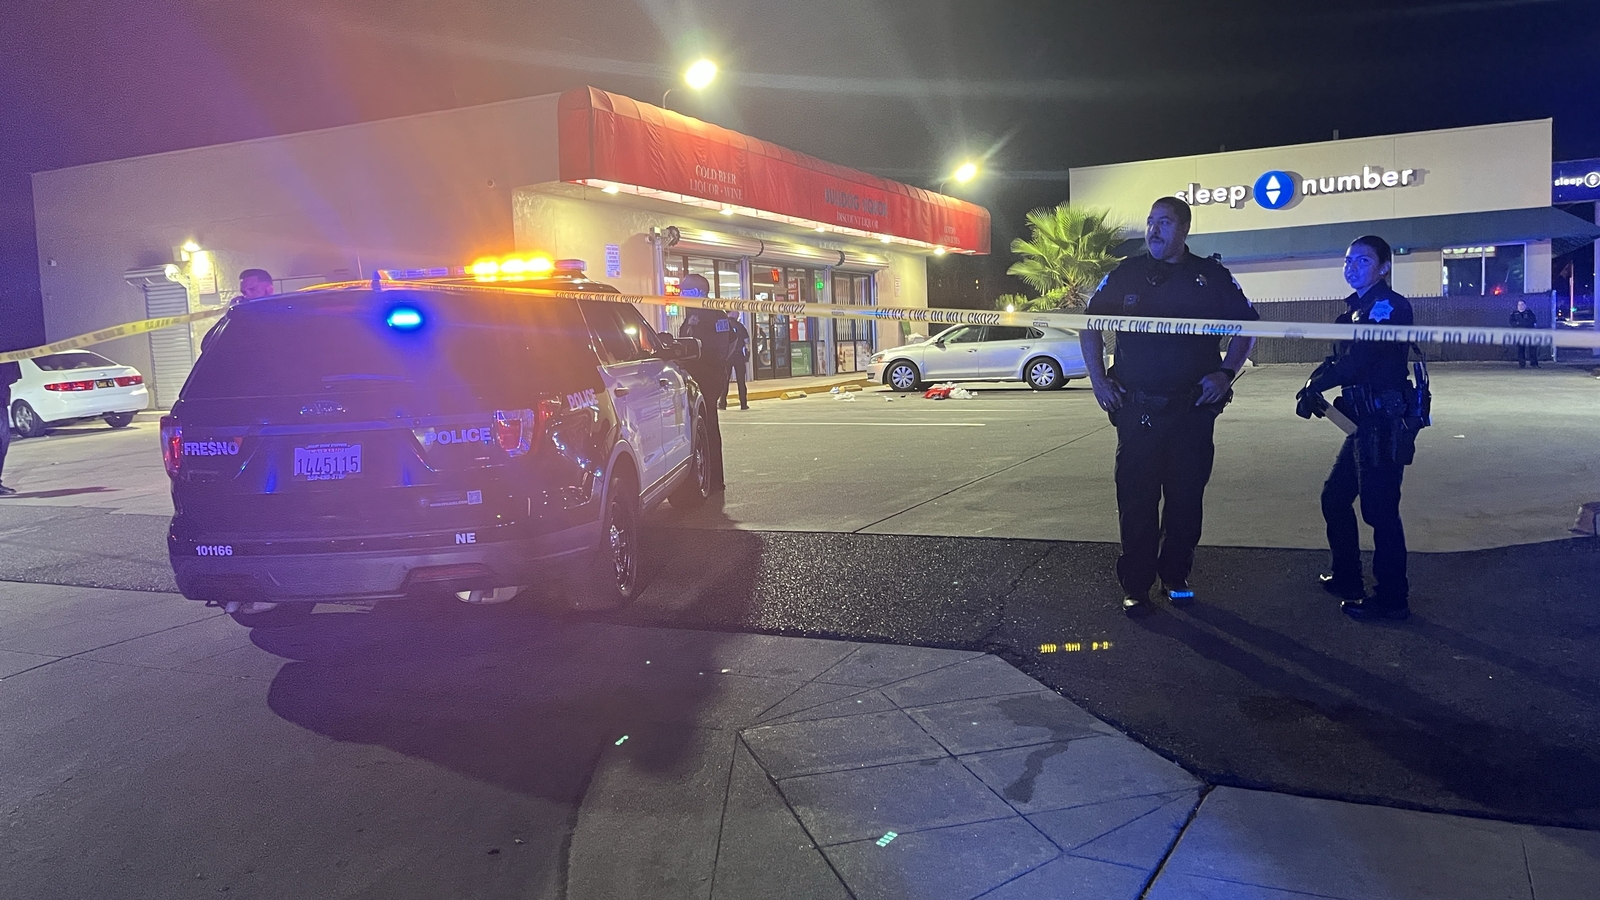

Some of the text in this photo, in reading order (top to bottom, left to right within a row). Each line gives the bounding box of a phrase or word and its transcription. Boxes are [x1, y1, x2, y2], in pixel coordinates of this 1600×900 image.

[695, 164, 737, 185] COLD BEER
[1554, 176, 1583, 187] sleep
[689, 178, 743, 200] LIQUOR WINE
[1174, 165, 1413, 208] sleep number
[566, 388, 599, 410] POLICE
[424, 427, 492, 446] POLICE
[184, 441, 239, 456] FRESNO
[298, 455, 358, 475] 1445115
[455, 533, 476, 544] NE
[195, 545, 233, 556] 101166
